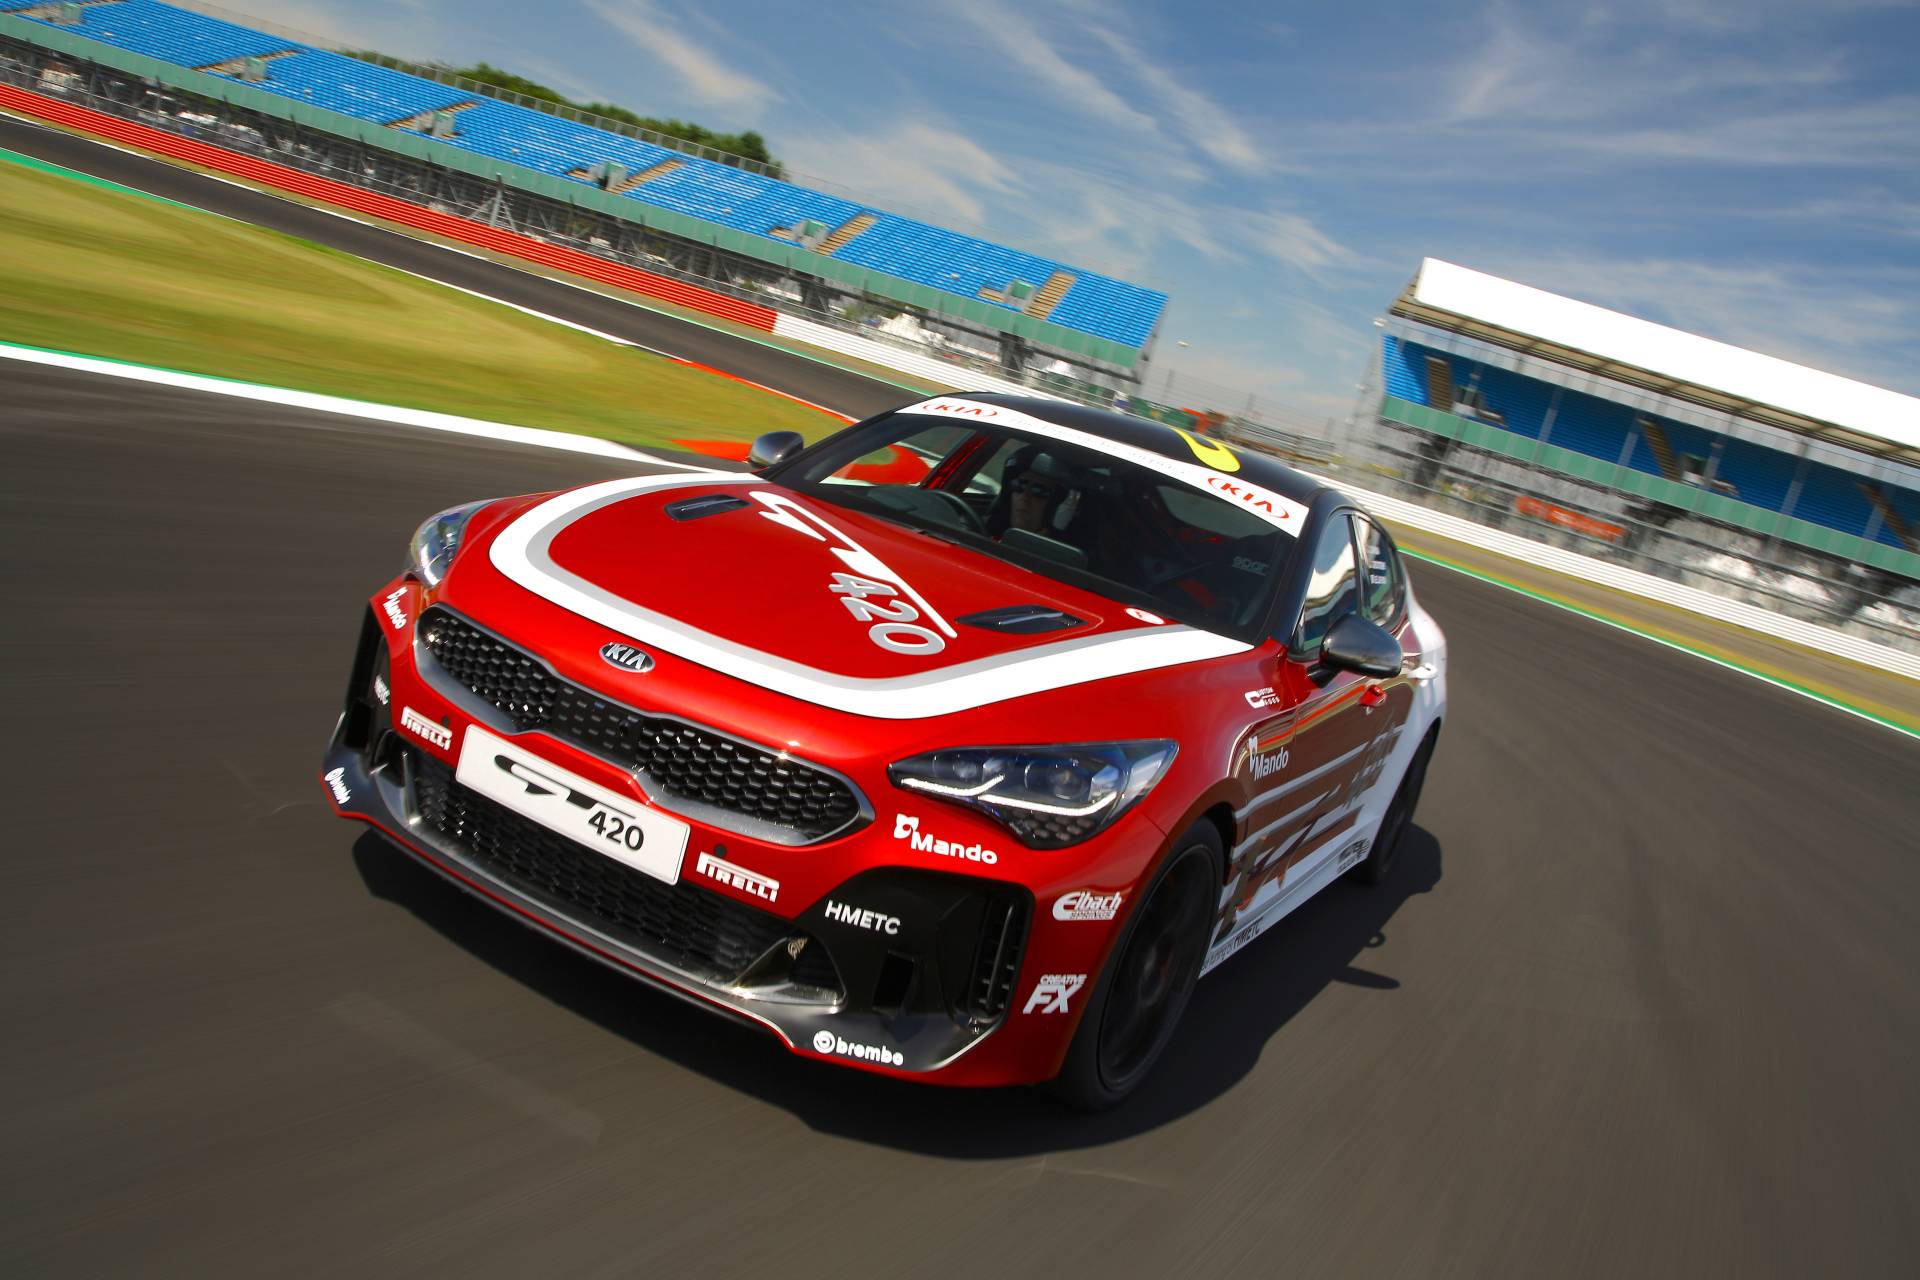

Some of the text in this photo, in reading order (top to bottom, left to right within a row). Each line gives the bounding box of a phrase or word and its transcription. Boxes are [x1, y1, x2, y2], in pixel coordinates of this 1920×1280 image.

[1218, 481, 1275, 514] KIA
[829, 572, 946, 655] 420
[605, 643, 649, 669] KIA
[401, 706, 452, 750] PIRELLI
[1254, 747, 1289, 780] Mando
[588, 811, 645, 851] 420
[911, 832, 998, 865] Mando
[696, 851, 779, 903] PIRELLI
[825, 900, 901, 935] HMETC
[1023, 983, 1083, 1014] FX
[836, 1036, 904, 1066] brembo
